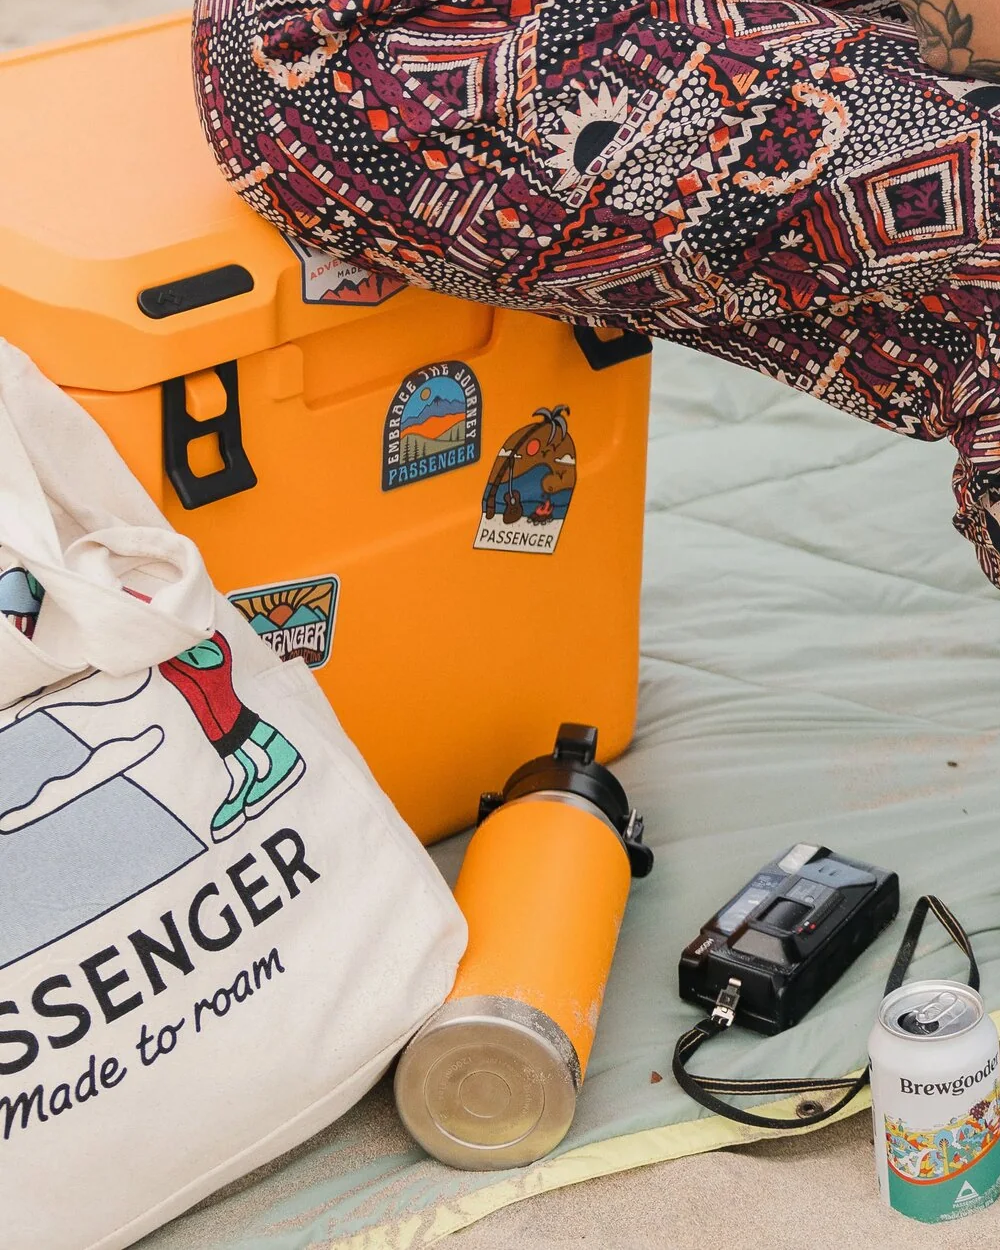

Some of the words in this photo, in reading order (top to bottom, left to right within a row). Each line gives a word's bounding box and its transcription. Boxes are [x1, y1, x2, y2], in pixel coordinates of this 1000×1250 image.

[310, 258, 342, 280] ADVE
[388, 380, 417, 465] EMBRACE
[418, 363, 449, 381] THE
[454, 369, 478, 439] JOURNEY
[388, 443, 475, 486] PASSENGER
[479, 528, 554, 548] PASSENGER
[136, 1017, 185, 1066] to
[194, 948, 285, 1032] roam
